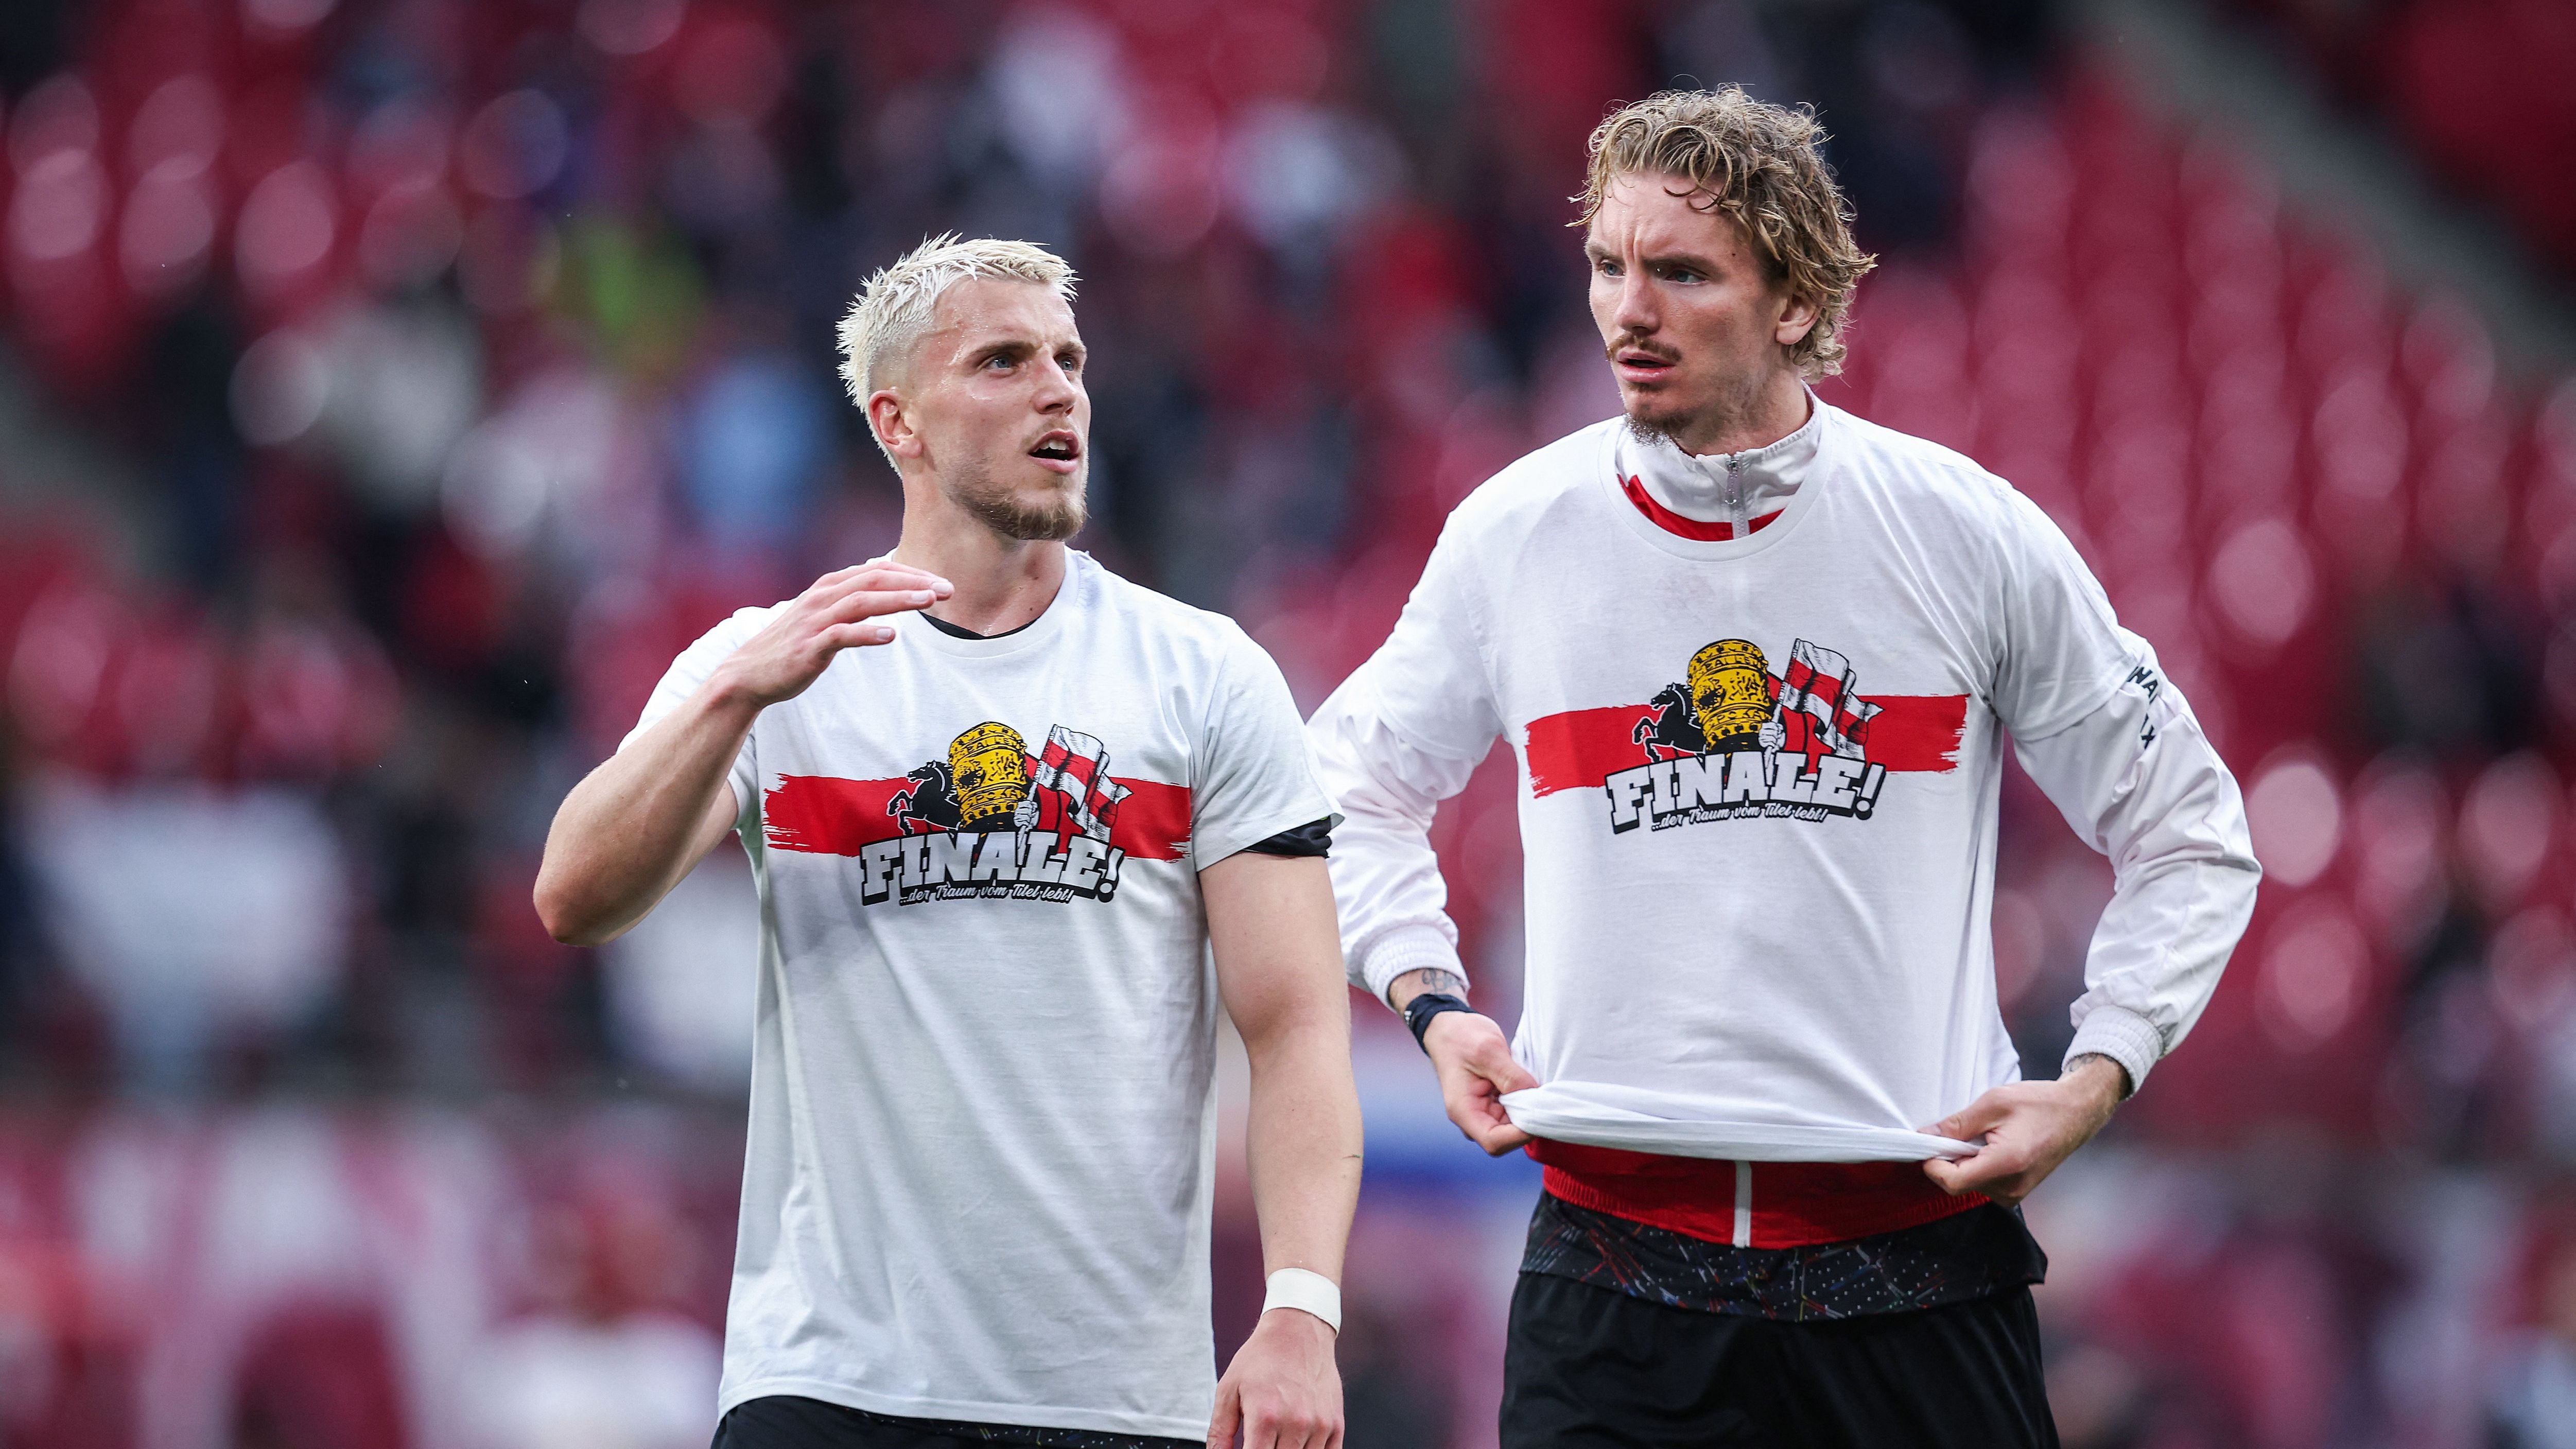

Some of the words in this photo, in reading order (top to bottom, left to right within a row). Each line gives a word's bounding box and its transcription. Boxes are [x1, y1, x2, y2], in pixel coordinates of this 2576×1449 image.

[1606, 750, 1886, 829] FINALE!
[1689, 807, 1731, 823] Traum
[1733, 806, 1761, 817] vom
[1765, 803, 1793, 817] Titel
[1794, 806, 1828, 820] lebt!
[860, 831, 1125, 901] FINALE!
[935, 883, 977, 899] Traum
[980, 886, 1008, 897] vom
[1013, 884, 1040, 898] Titel
[1041, 886, 1074, 901] lebt!
